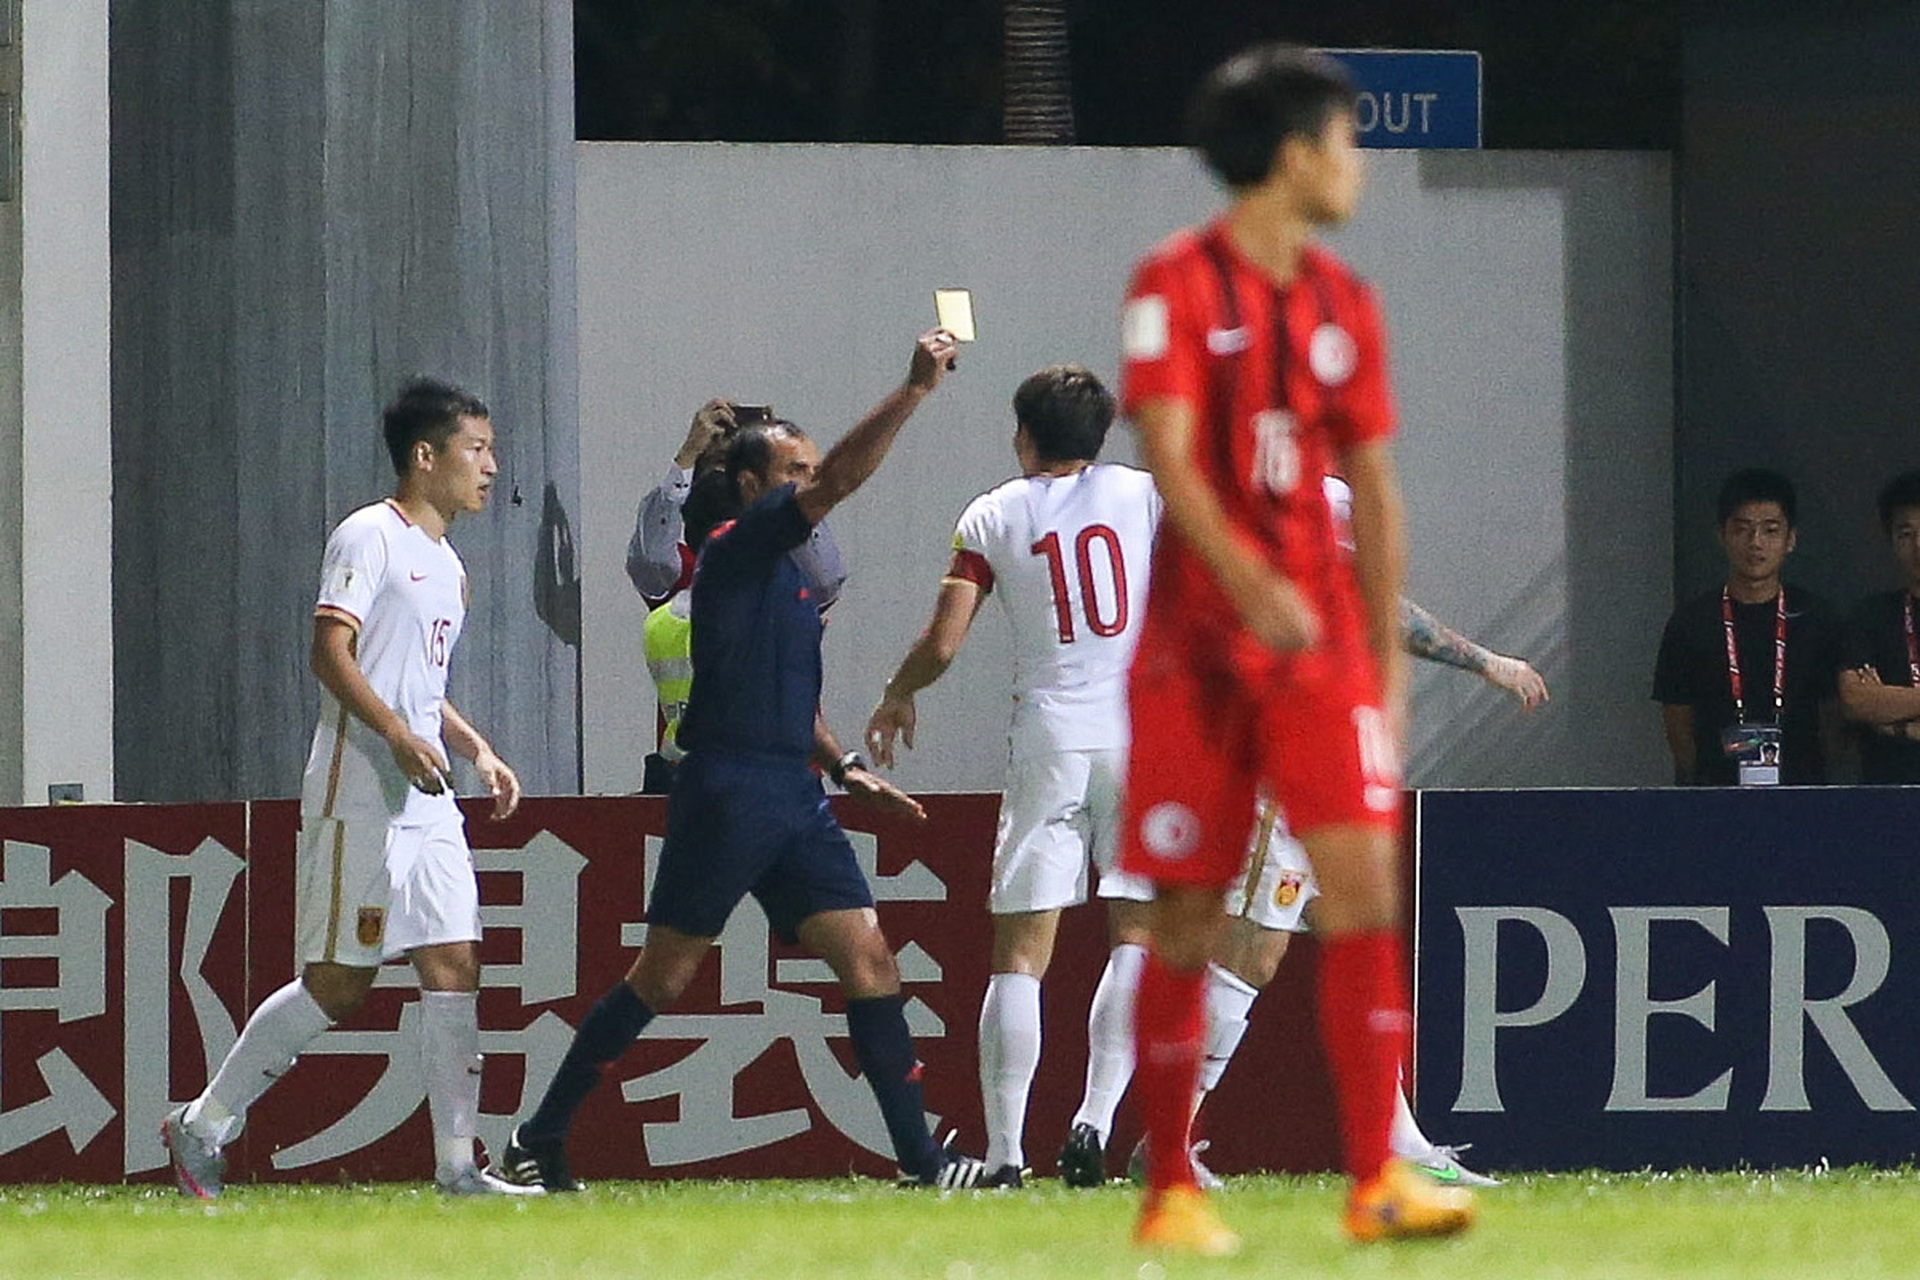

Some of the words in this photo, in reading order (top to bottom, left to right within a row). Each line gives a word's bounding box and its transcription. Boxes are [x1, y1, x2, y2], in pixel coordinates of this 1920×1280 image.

[1354, 91, 1437, 133] OUT
[1031, 524, 1128, 643] 10
[430, 617, 451, 668] 15
[1450, 905, 1918, 1112] PER
